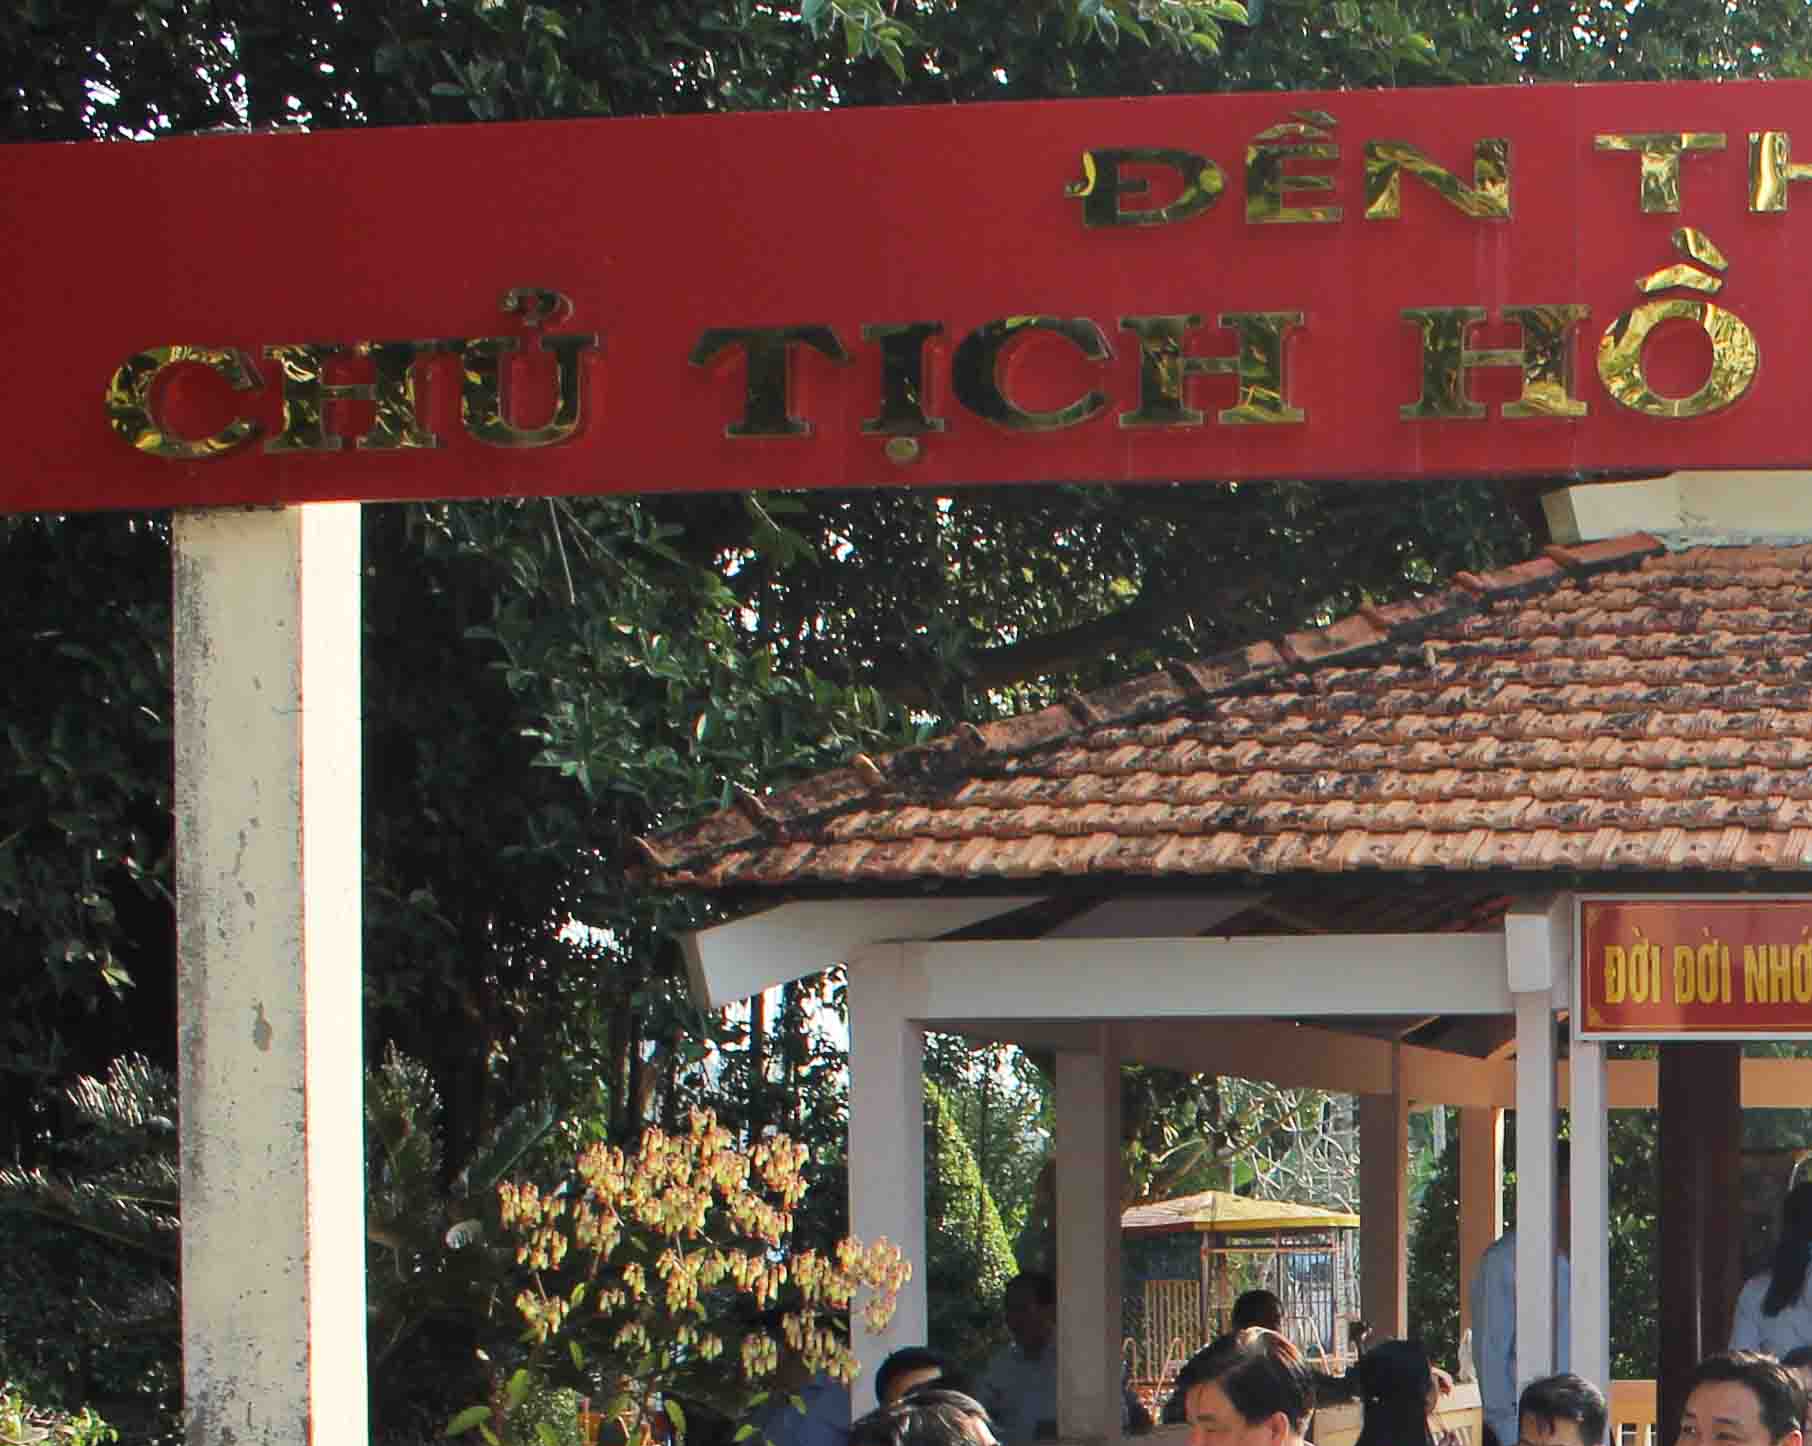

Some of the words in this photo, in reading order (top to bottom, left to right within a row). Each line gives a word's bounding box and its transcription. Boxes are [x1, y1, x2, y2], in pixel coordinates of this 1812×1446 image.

[1065, 110, 1512, 226] ĐỀN
[104, 287, 602, 460] CHỦ
[690, 310, 1307, 460] TỊCH
[1400, 226, 1764, 423] HỒ
[1604, 927, 1663, 1004] ĐỜI
[1673, 927, 1731, 1005] ĐỜI
